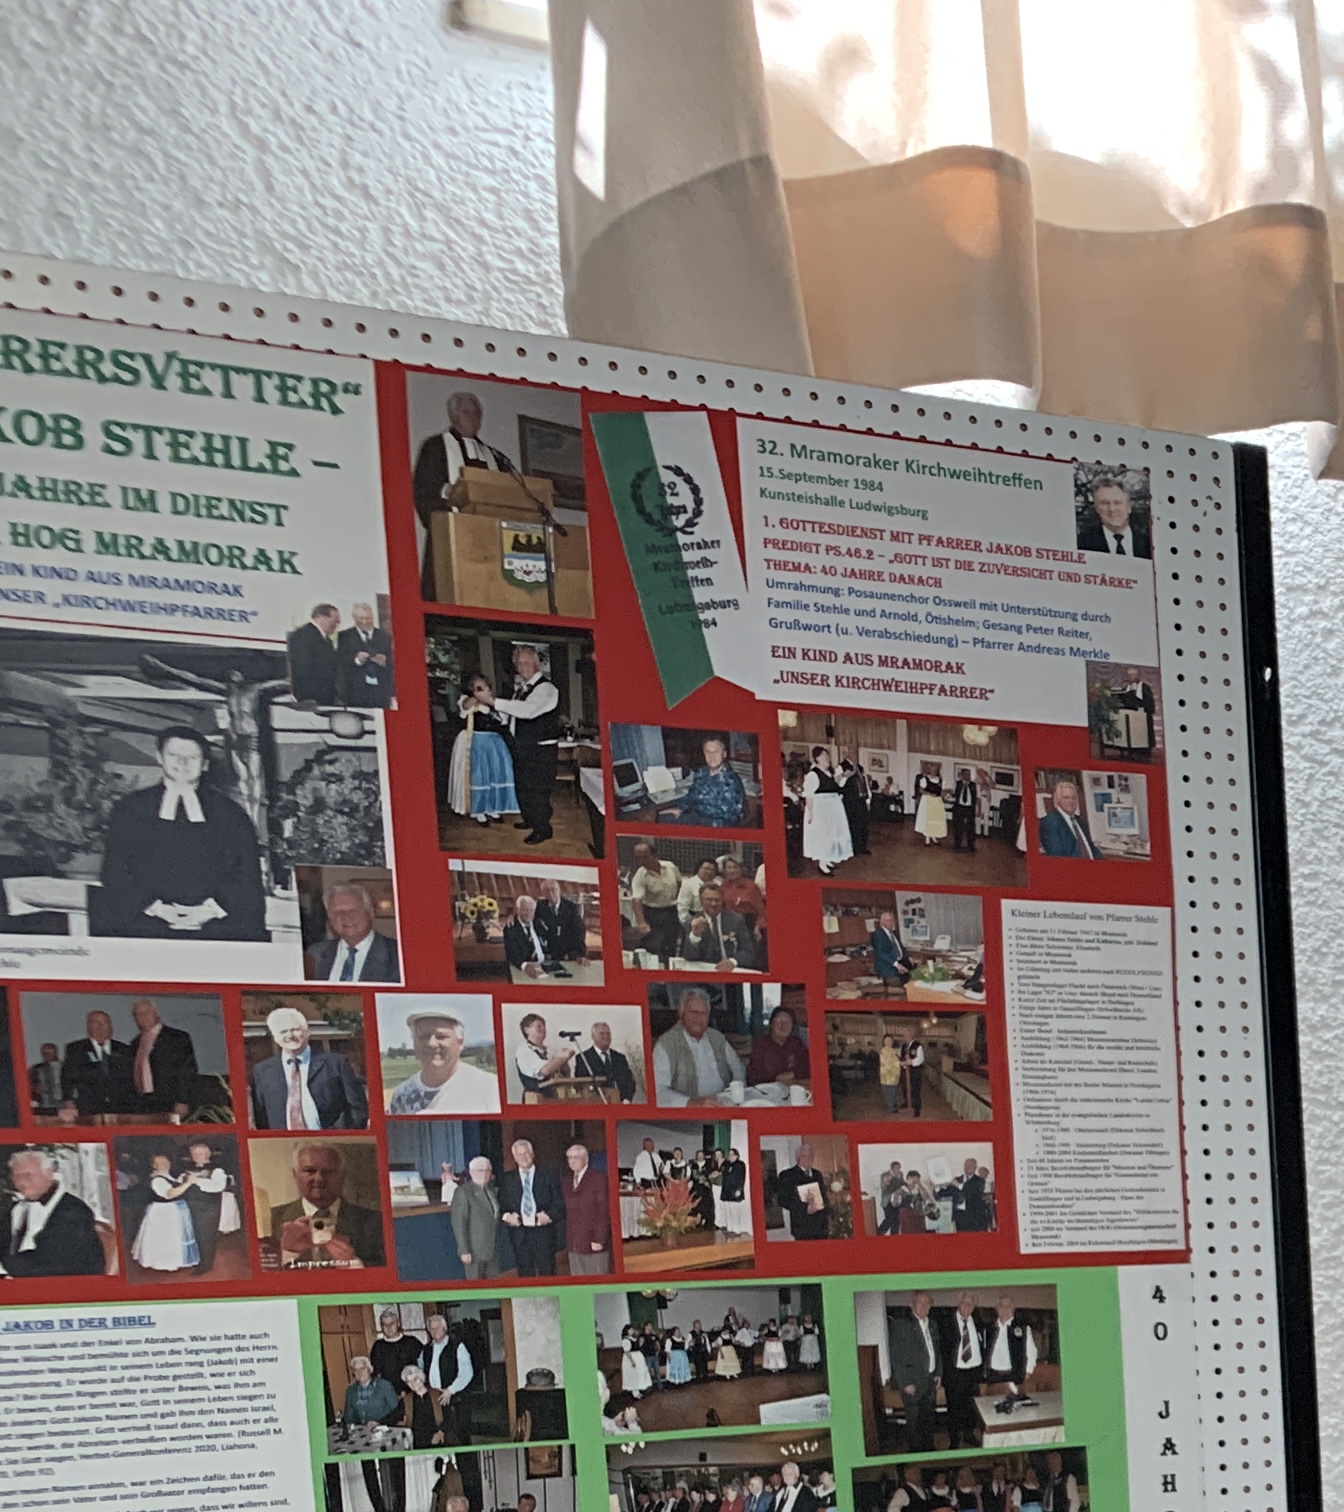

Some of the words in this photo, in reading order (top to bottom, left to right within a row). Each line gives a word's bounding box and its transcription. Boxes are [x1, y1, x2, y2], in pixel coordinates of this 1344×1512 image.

[101, 419, 301, 478] STEHLE
[756, 438, 784, 457] 32.
[790, 442, 899, 472] Mramoraker
[905, 458, 1044, 492] Kirchweihtreffen
[118, 485, 161, 513] IM
[168, 491, 289, 527] DIENST
[760, 487, 845, 509] Kunsteishalle
[849, 498, 929, 521] Ludwigsburg
[853, 478, 884, 492] 1984
[8, 521, 86, 553] HOG
[93, 530, 303, 575] MRAMORAK
[763, 516, 775, 528] 1.
[780, 517, 886, 541] GOTTESDIENST
[890, 530, 914, 545] MIT
[917, 534, 983, 553] PFARRER
[986, 542, 1033, 558] JAKOB
[1036, 548, 1087, 565] STEHLE
[763, 537, 821, 556] PREDIGT
[931, 557, 951, 570] IST
[954, 559, 975, 572] DIE
[978, 562, 1054, 581] ZUVERSICHT
[1058, 571, 1081, 584] UND
[31, 564, 79, 581] KIND
[85, 570, 123, 586] AUS
[128, 573, 245, 598] MRAMORAK
[763, 558, 817, 575] THEMA:
[820, 564, 837, 577] 40
[841, 566, 885, 583] JAHRE
[888, 572, 943, 588] DANACH
[766, 577, 845, 598] Umrahmung:
[848, 587, 929, 605] Posaunenchor
[932, 595, 976, 610] Ossweil
[980, 602, 998, 612] mit
[1001, 602, 1078, 622] Unterstützung
[1081, 610, 1111, 624] durch
[767, 597, 810, 612] Familie
[813, 602, 850, 616] Stehle
[854, 607, 876, 619] und
[880, 609, 922, 625] Arnold,
[925, 611, 981, 631] Ötisheim;
[982, 619, 1023, 635] Gesang
[1026, 623, 1054, 636] Peter
[1057, 627, 1093, 641] Reiter,
[769, 617, 832, 635] Grußwort
[856, 625, 959, 648] Verabschiedung)
[973, 637, 1014, 651] Pfarrer
[1017, 642, 1066, 656] Andreas
[1069, 646, 1110, 660] Merkle
[771, 645, 796, 660] EIN
[802, 648, 838, 663] KIND
[843, 652, 874, 667] AUS
[878, 655, 966, 676] MRAMORAK
[773, 670, 831, 687] „UNSER
[1011, 909, 1041, 919] Kleiner
[1106, 913, 1133, 923] Pfarrer
[2, 1319, 55, 1332] JAKOB
[59, 1318, 74, 1330] IN
[78, 1316, 108, 1329] DER
[111, 1314, 157, 1328] BIBEL
